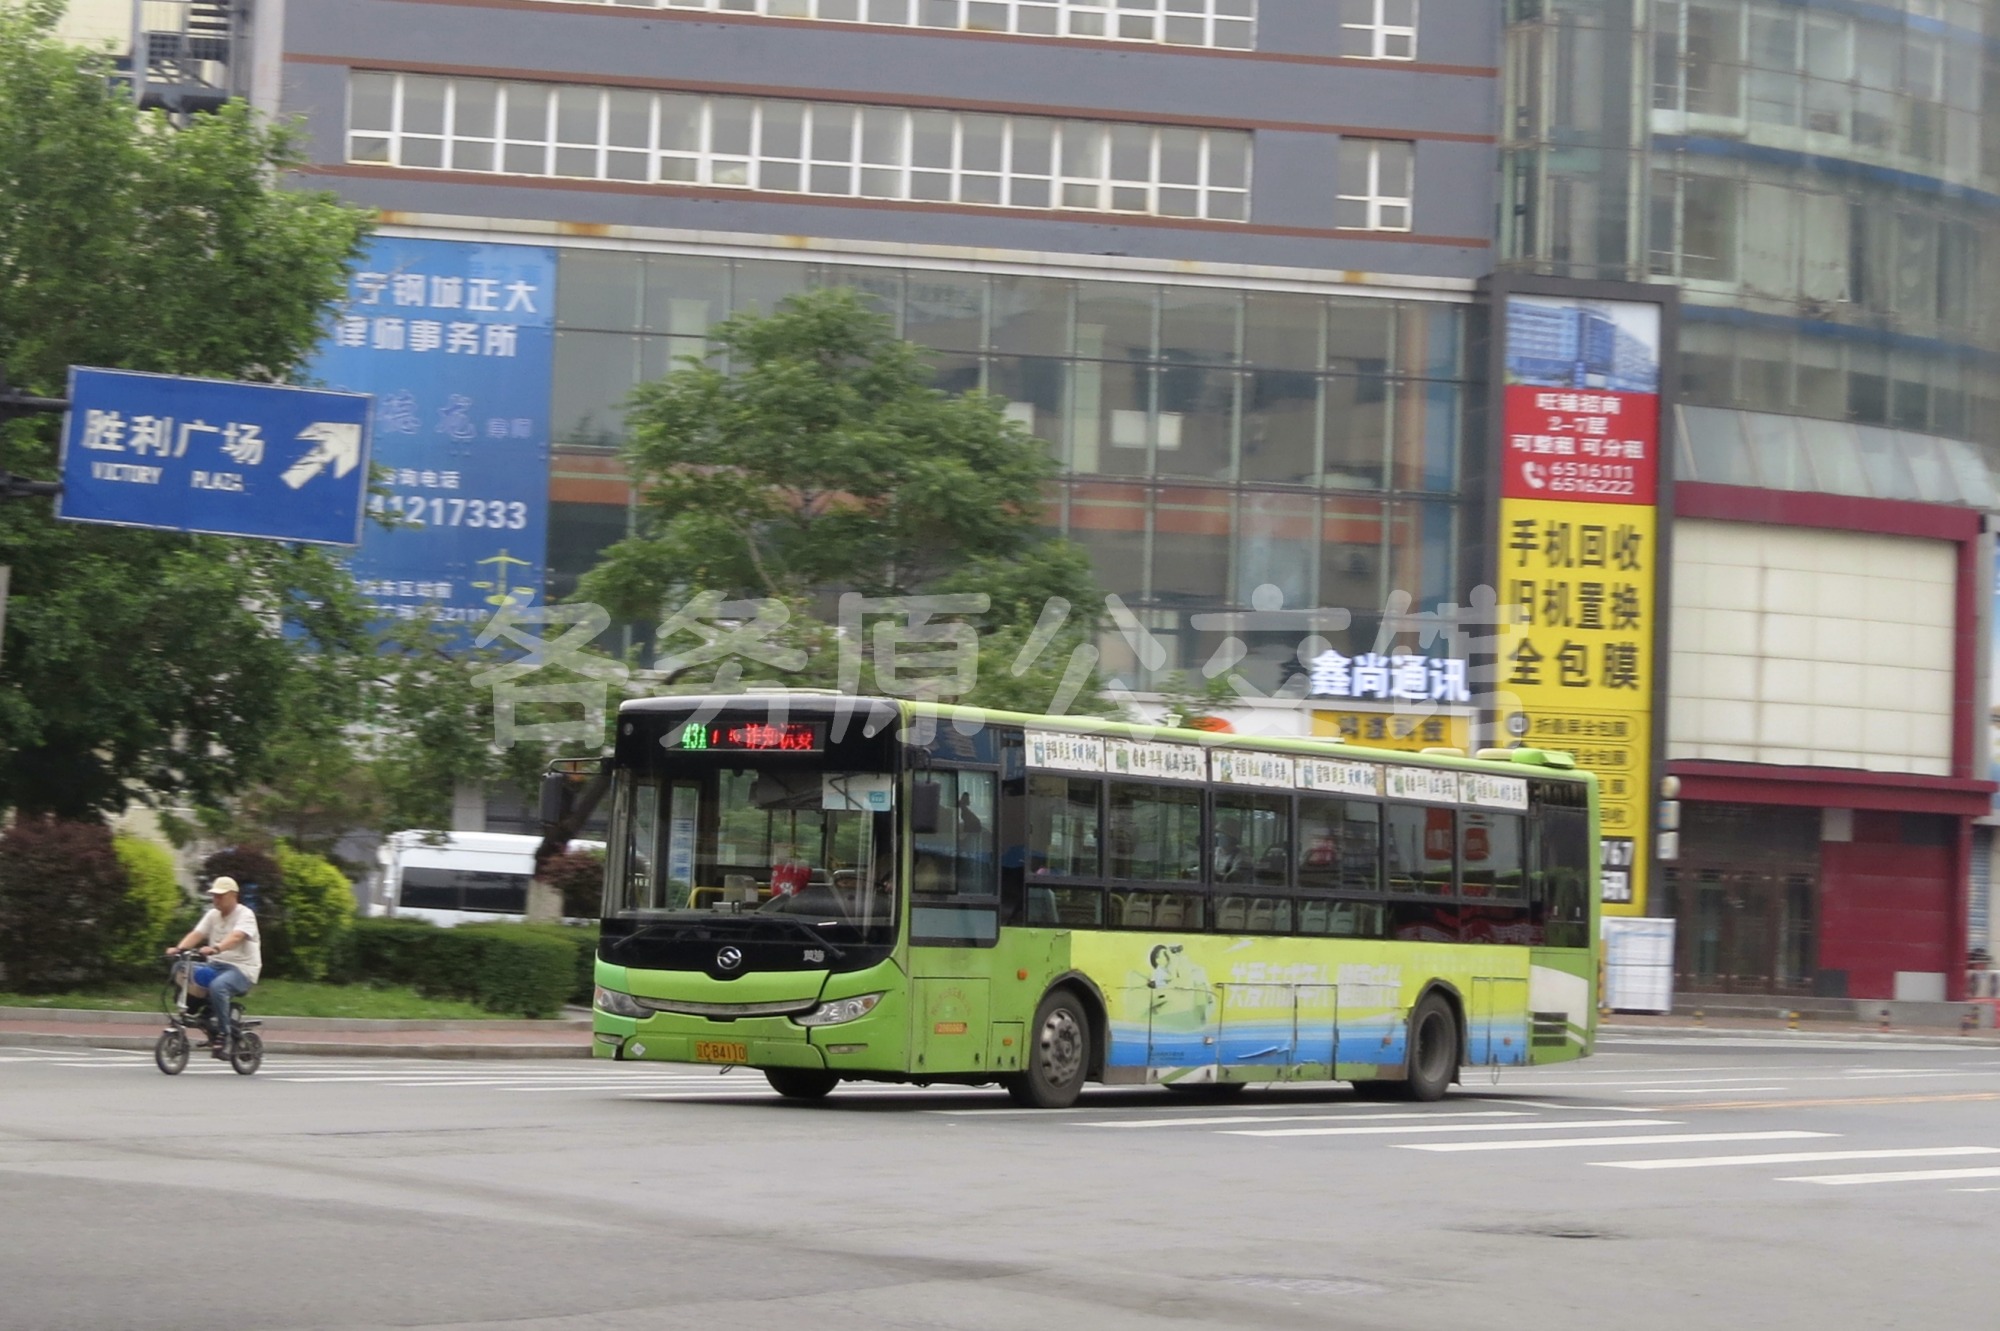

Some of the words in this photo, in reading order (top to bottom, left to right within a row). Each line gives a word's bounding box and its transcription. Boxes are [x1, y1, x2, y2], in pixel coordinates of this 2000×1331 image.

[333, 271, 538, 313] 宁钢城正大
[335, 315, 518, 357] 律师事务所
[82, 408, 266, 465] 胜利广场
[91, 460, 164, 485] VICTORY
[1549, 461, 1633, 480] 6516111
[1549, 477, 1634, 495] 6516222
[1508, 518, 1642, 572] 手机回收
[1509, 578, 1641, 631] 旧机置换
[1311, 650, 1471, 702] 鑫尚通讯
[1508, 637, 1640, 692] 全包膜
